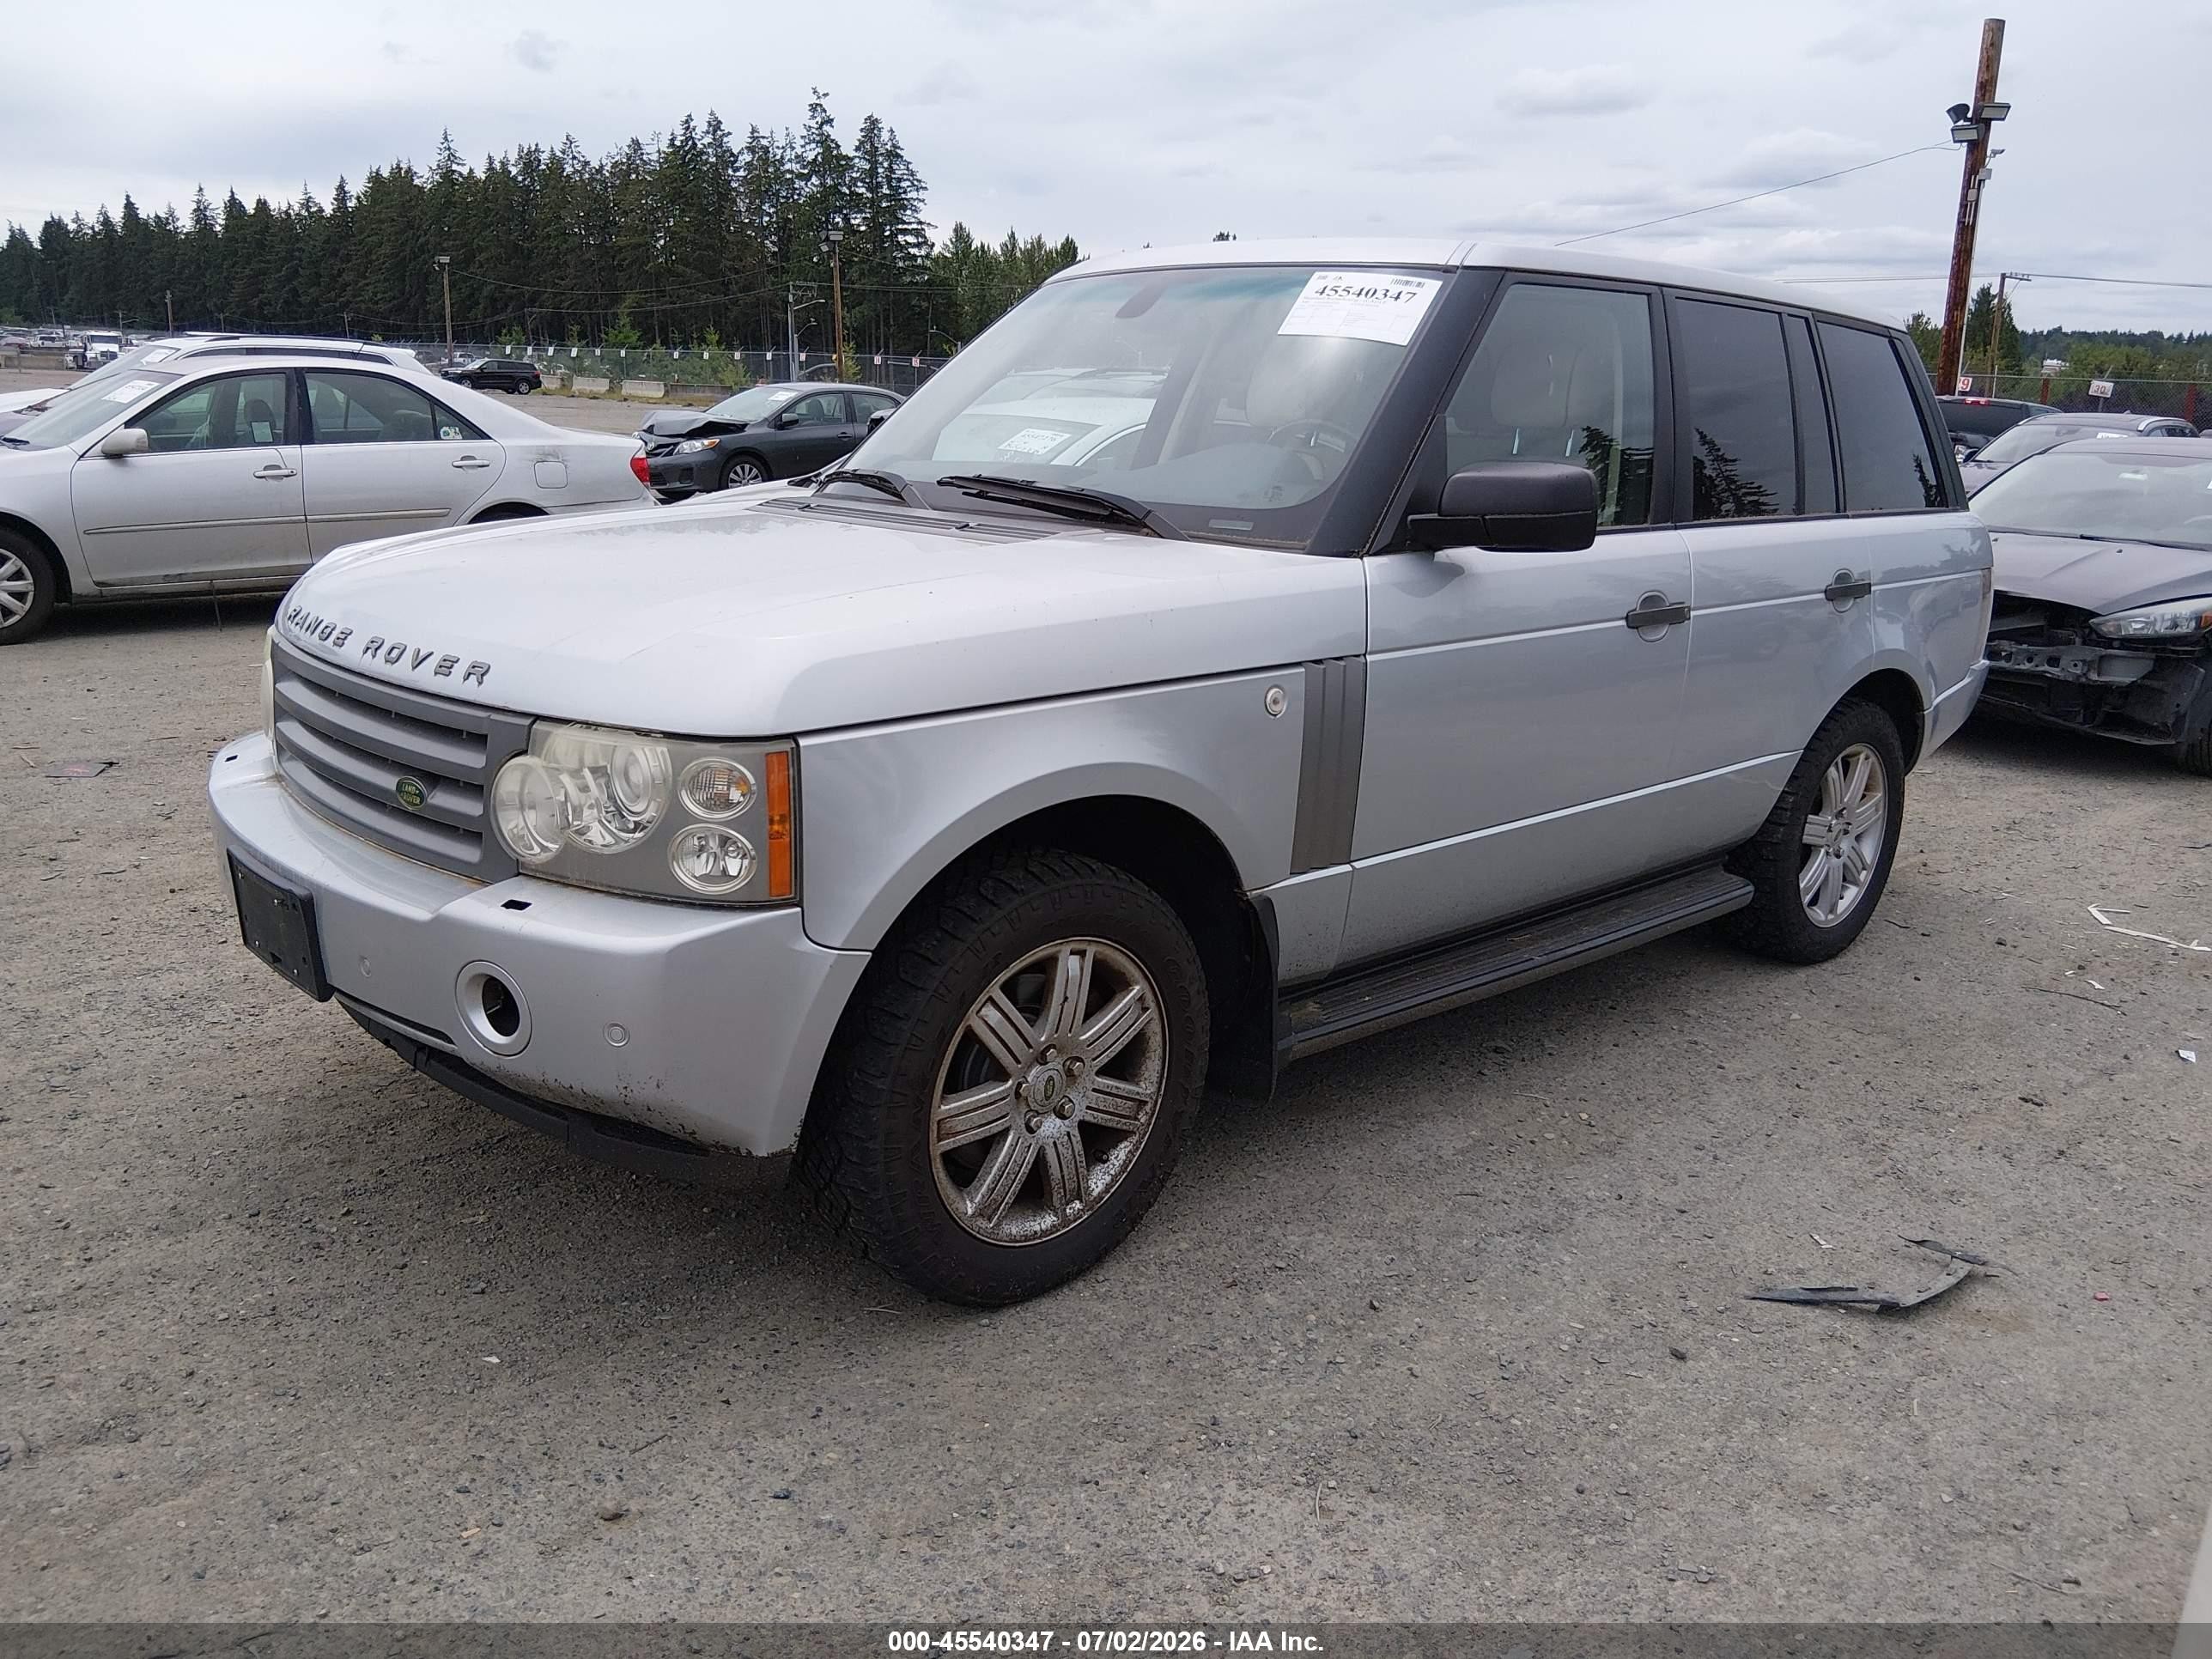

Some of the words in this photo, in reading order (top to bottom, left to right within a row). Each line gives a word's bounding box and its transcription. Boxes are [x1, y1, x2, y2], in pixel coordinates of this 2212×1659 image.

[1314, 284, 1418, 303] 45540347
[2094, 384, 2106, 395] 30
[288, 605, 354, 648] RANGE
[362, 636, 491, 687] ROVER
